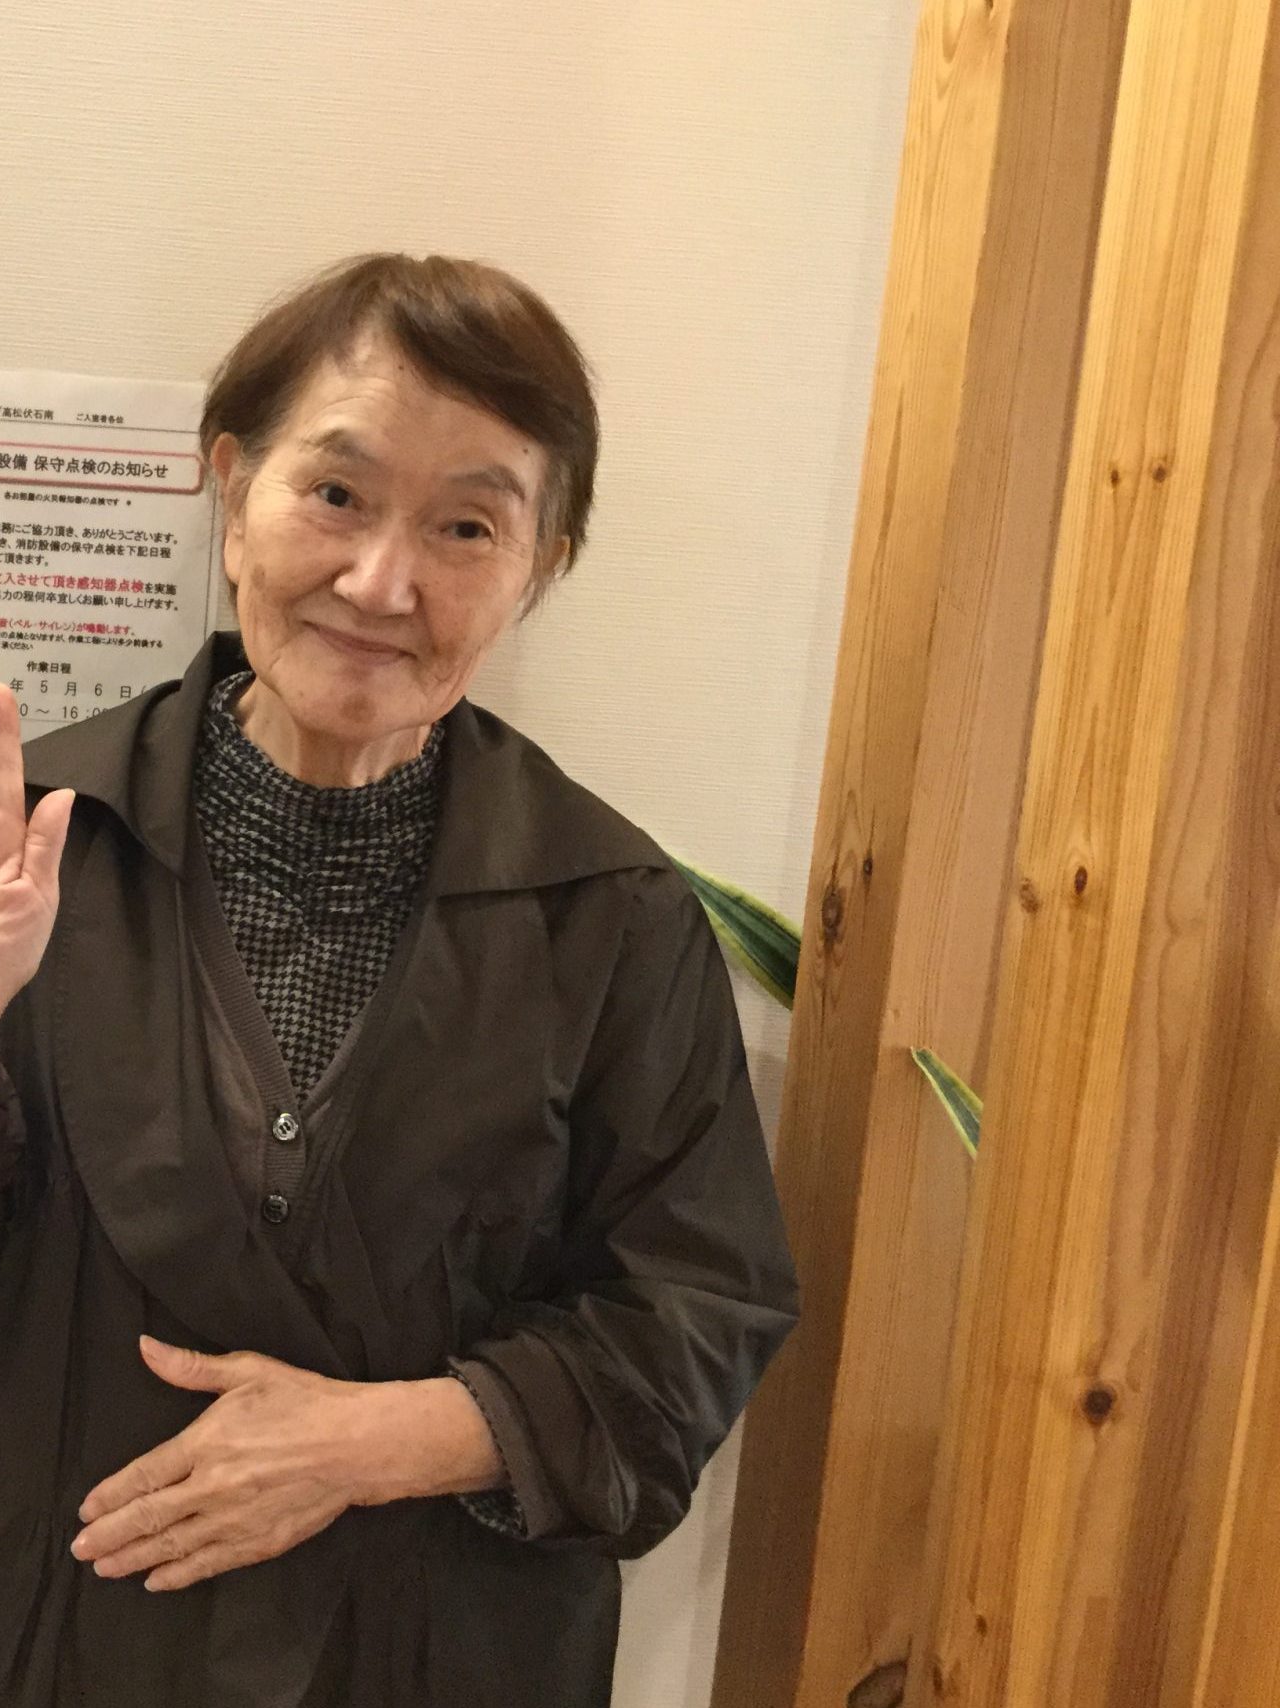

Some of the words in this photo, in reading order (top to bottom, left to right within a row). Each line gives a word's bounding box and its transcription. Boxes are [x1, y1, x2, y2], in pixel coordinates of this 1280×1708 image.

[34, 455, 169, 478] 保守点検のお知らせ
[27, 660, 72, 675] 作業日程
[9, 678, 24, 693] 年
[40, 680, 48, 694] 5
[64, 682, 77, 697] 月
[94, 683, 103, 698] 6
[120, 685, 132, 699] 日
